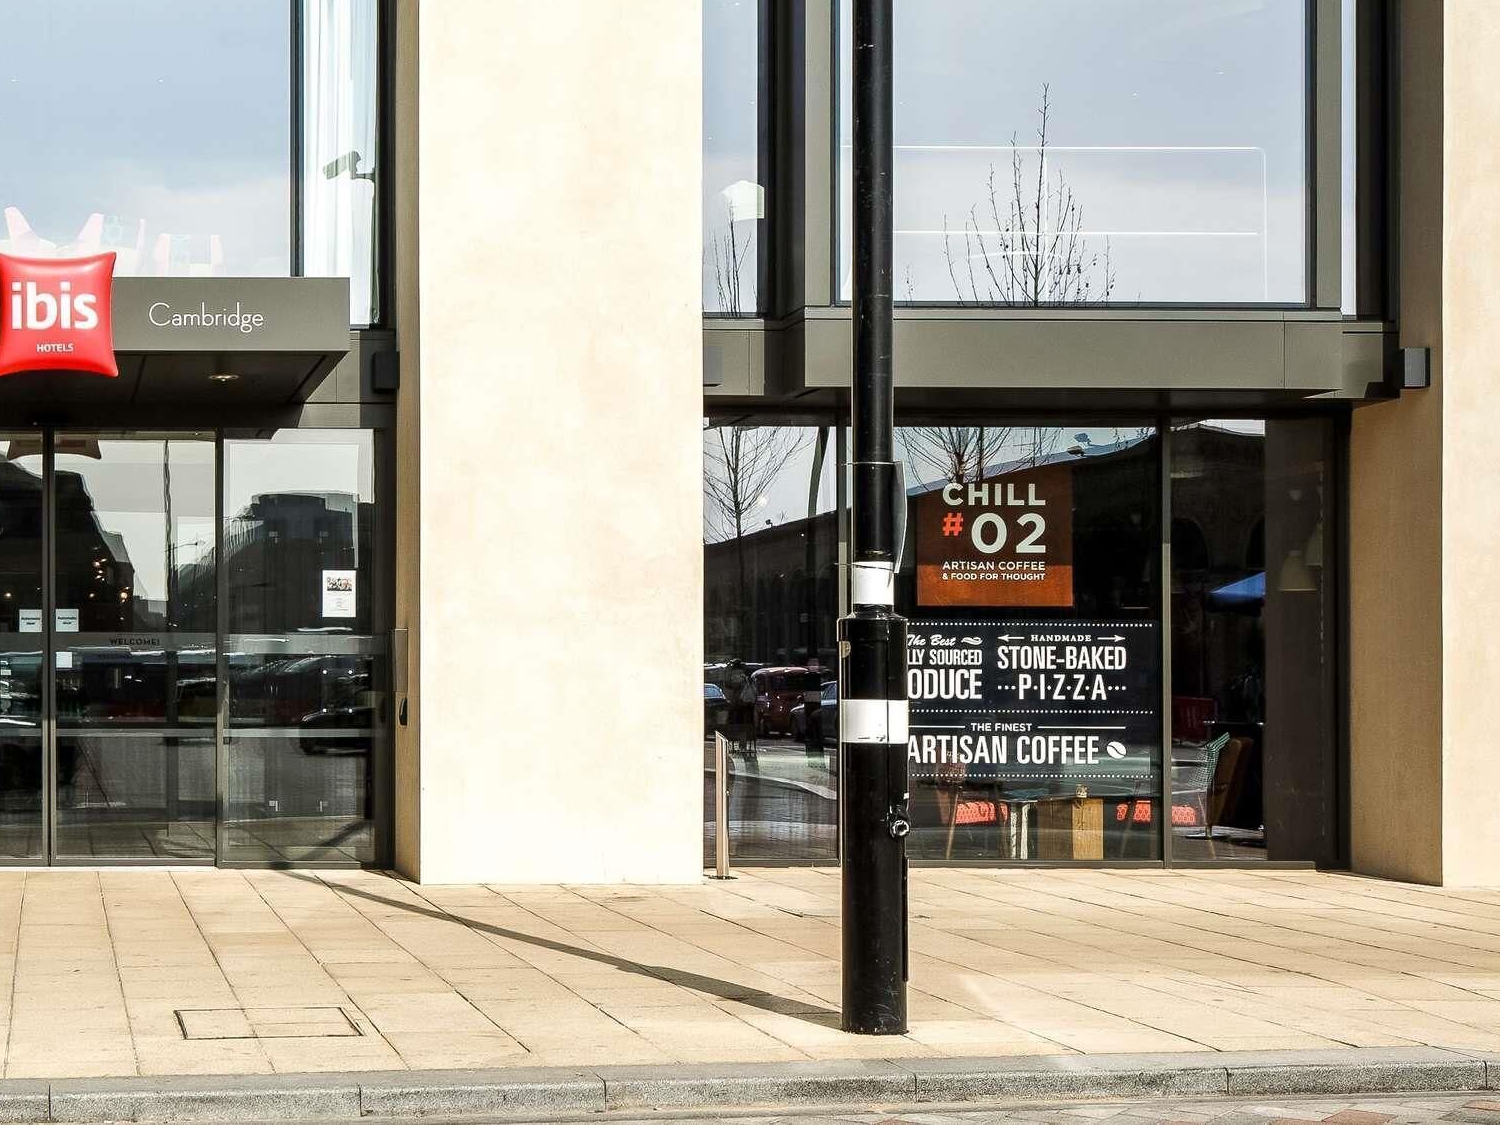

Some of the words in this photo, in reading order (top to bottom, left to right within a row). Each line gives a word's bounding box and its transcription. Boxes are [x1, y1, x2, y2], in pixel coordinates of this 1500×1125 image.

[11, 281, 99, 330] ibis
[149, 302, 264, 333] Cambridge
[36, 343, 74, 352] HOTELS
[942, 482, 1046, 506] CHILL
[942, 561, 994, 571] ARTISAN
[998, 561, 1045, 571] COFFEE
[951, 572, 978, 581] FOOD
[980, 572, 999, 581] FOR
[1001, 572, 1046, 581] THOUGHT
[109, 637, 160, 645] WELCOME!
[907, 634, 926, 646] The
[930, 634, 956, 647] Best
[1030, 634, 1092, 642] HANDMADE
[929, 649, 982, 665] SOURCED
[997, 645, 1127, 670] STONE-BAKED
[970, 723, 992, 731] THE
[995, 723, 1032, 732] FINEST
[908, 735, 1007, 764] ARTISAN
[1017, 735, 1100, 764] COFFEE
